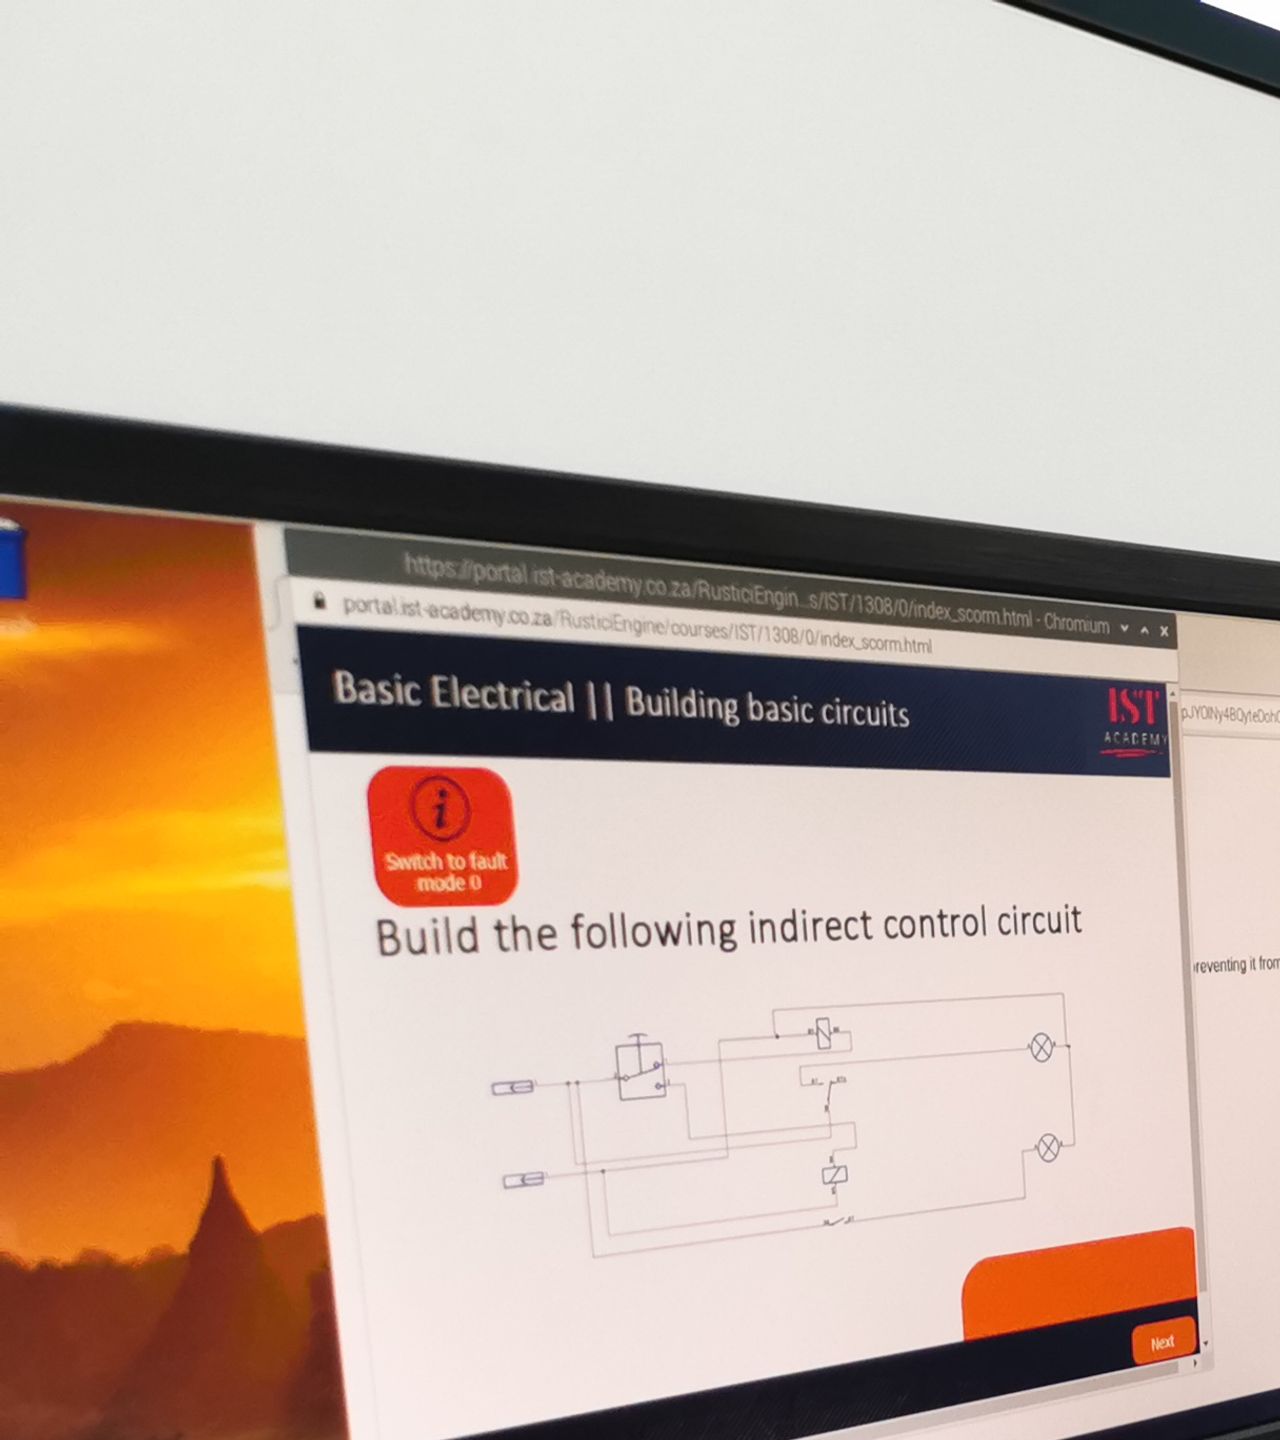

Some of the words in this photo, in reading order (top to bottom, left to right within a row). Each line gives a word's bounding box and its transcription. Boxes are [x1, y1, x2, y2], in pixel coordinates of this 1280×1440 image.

[1044, 612, 1110, 636] Chromium
[333, 670, 423, 709] Basic
[430, 674, 575, 714] Electrical
[625, 685, 739, 728] Building
[746, 691, 815, 724] basic
[820, 699, 911, 729] circuits
[1107, 686, 1161, 726] IST
[1103, 731, 1169, 747] ACADEMY
[384, 852, 444, 873] Switch
[446, 853, 467, 871] to
[468, 850, 509, 872] fault
[416, 874, 466, 893] mode
[469, 874, 482, 892] 0
[375, 915, 480, 957] Build
[493, 914, 559, 951] the
[570, 911, 738, 953] following
[749, 907, 874, 944] indirect
[883, 903, 988, 940] control
[997, 903, 1083, 936] circuit
[1249, 955, 1257, 971] it
[1150, 1333, 1176, 1352] Next
